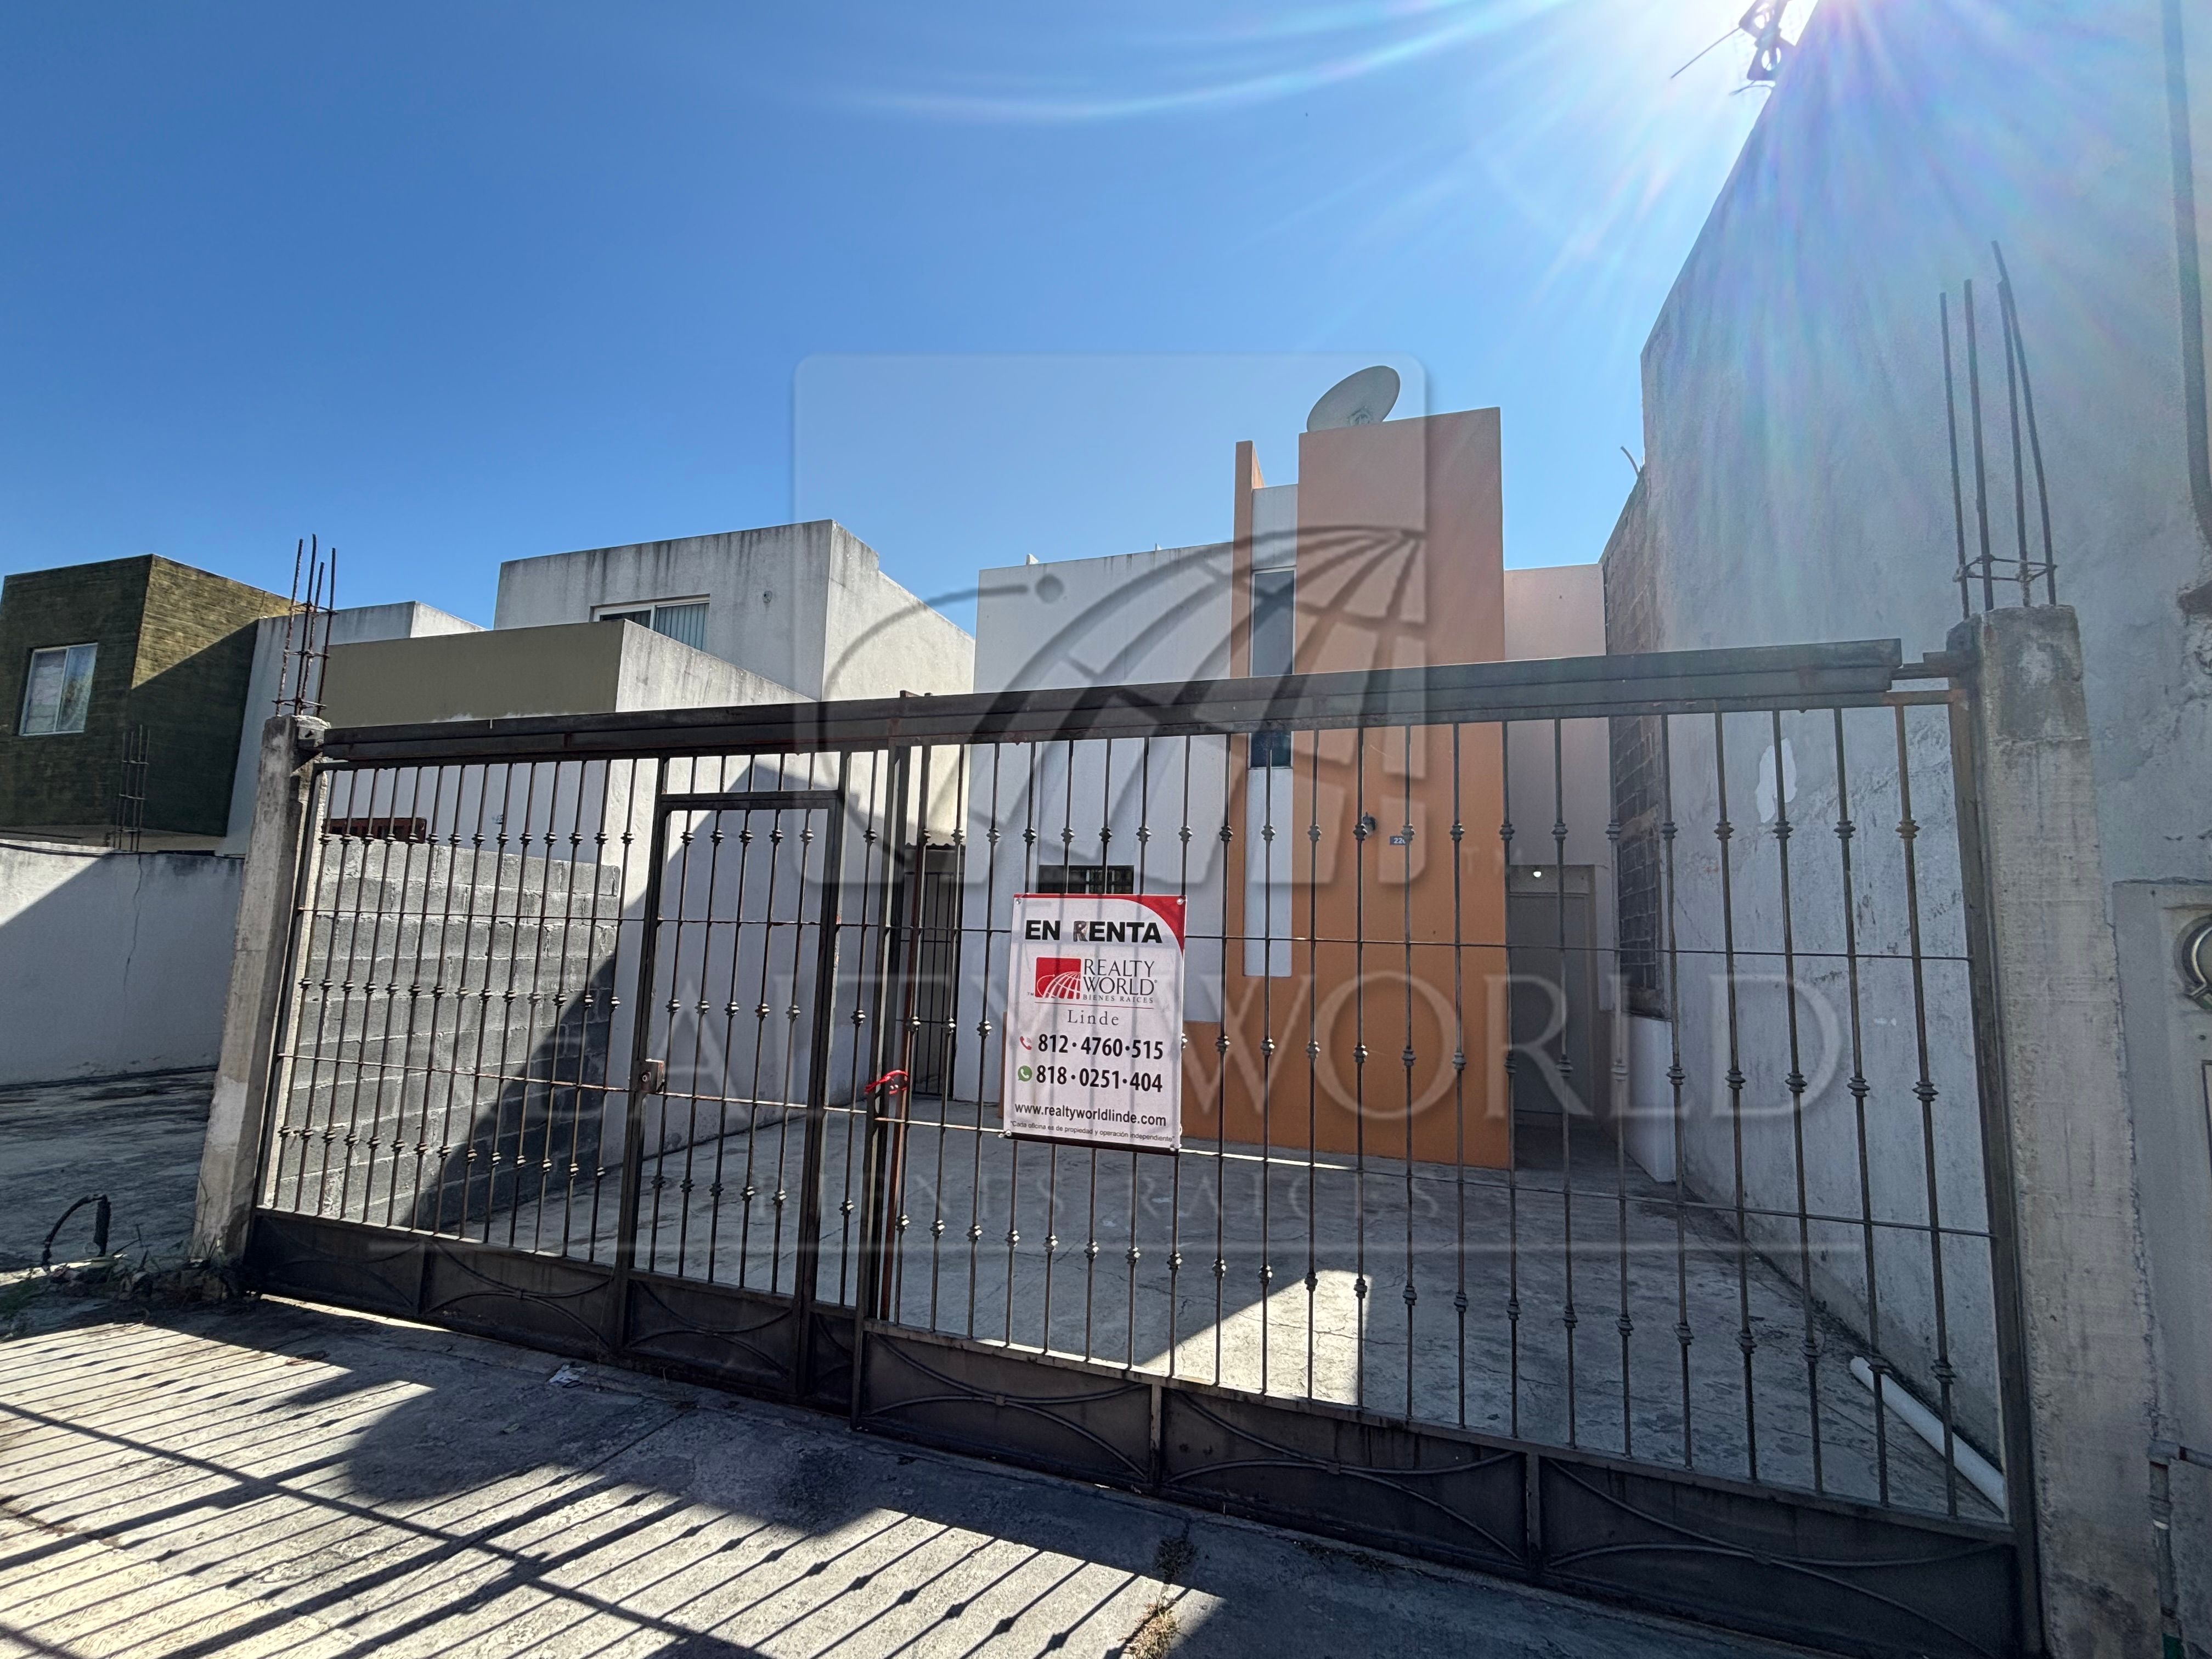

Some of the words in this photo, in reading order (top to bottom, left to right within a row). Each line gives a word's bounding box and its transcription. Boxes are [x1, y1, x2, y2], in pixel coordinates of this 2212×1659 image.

[1025, 920, 1061, 940] EN
[1073, 921, 1163, 944] RENTA
[1084, 958, 1155, 977] REALTY
[1082, 976, 1155, 996] WORLD
[1068, 1009, 1119, 1026] Linde
[1014, 1103, 1167, 1127] www.realtyworldlinde.com
